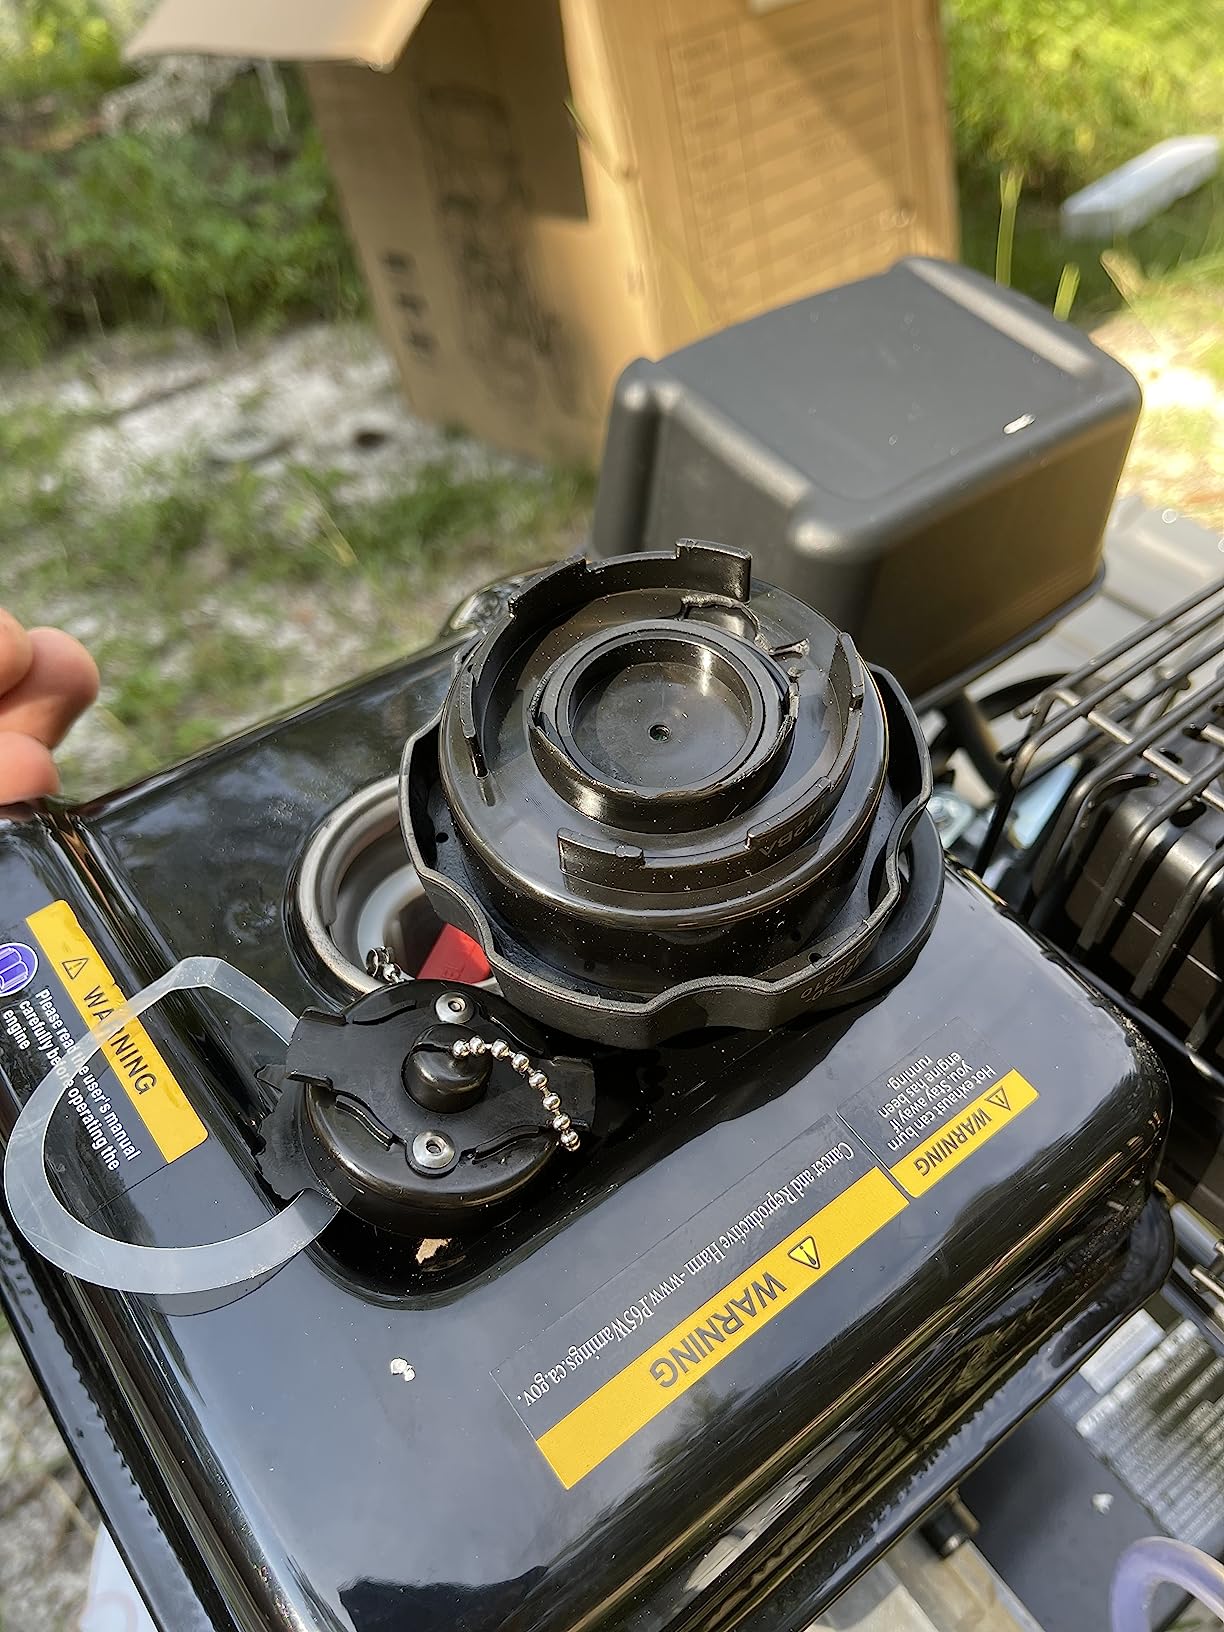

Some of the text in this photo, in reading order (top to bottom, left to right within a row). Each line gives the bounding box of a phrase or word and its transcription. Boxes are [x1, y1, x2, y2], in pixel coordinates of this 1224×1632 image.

[2, 1009, 31, 1050] engine
[20, 1000, 121, 1171] carefully before operating the
[35, 988, 64, 1030] Please
[56, 1027, 78, 1055] read
[83, 1074, 112, 1114] user's
[104, 1112, 142, 1162] manual
[878, 1052, 961, 1119] engine has been
[886, 1054, 934, 1091] running.
[888, 1060, 973, 1134] you. Stay away if
[887, 1064, 997, 1152] Hot exhaust can burn
[811, 1141, 855, 1178] Cancer
[913, 1107, 993, 1177] WARNING
[718, 1184, 800, 1249] Reproductive
[789, 1168, 815, 1199] and
[683, 1240, 727, 1276] Harm
[650, 1271, 788, 1389] WARNING
